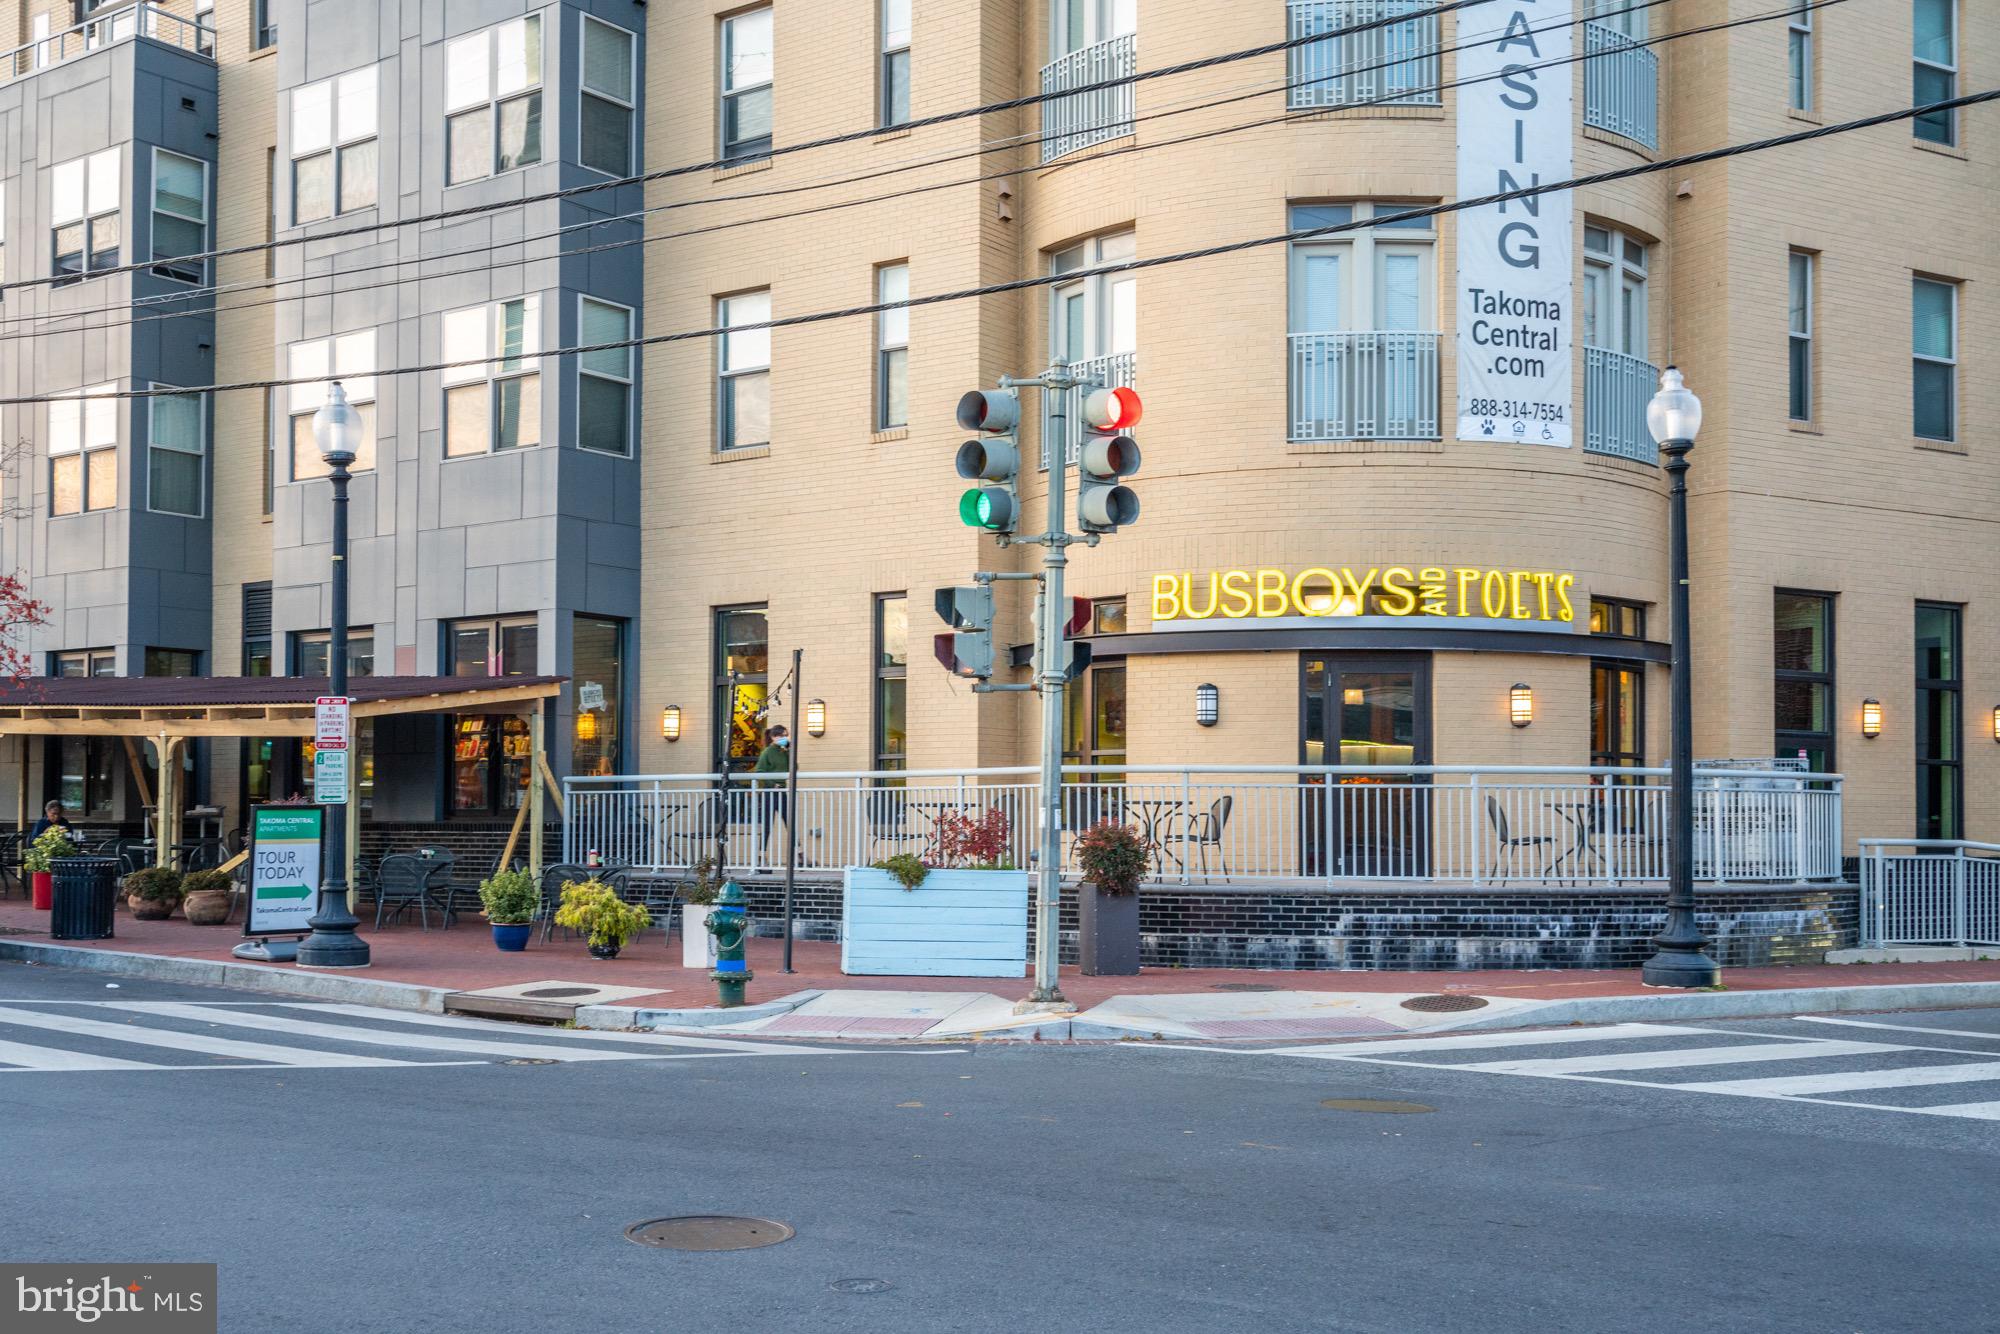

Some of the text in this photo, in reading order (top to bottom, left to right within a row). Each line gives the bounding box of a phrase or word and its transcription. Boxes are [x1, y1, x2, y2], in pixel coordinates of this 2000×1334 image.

[1496, 0, 1541, 269] ASING
[1468, 288, 1560, 321] Takoma
[1472, 320, 1558, 351] Central
[1487, 356, 1544, 378] .com
[1470, 398, 1564, 422] 888-314-7554
[1152, 567, 1575, 622] BUSBOYS AND POETS
[318, 754, 323, 764] 2
[258, 851, 296, 865] TOUR
[257, 866, 305, 880] TODAY
